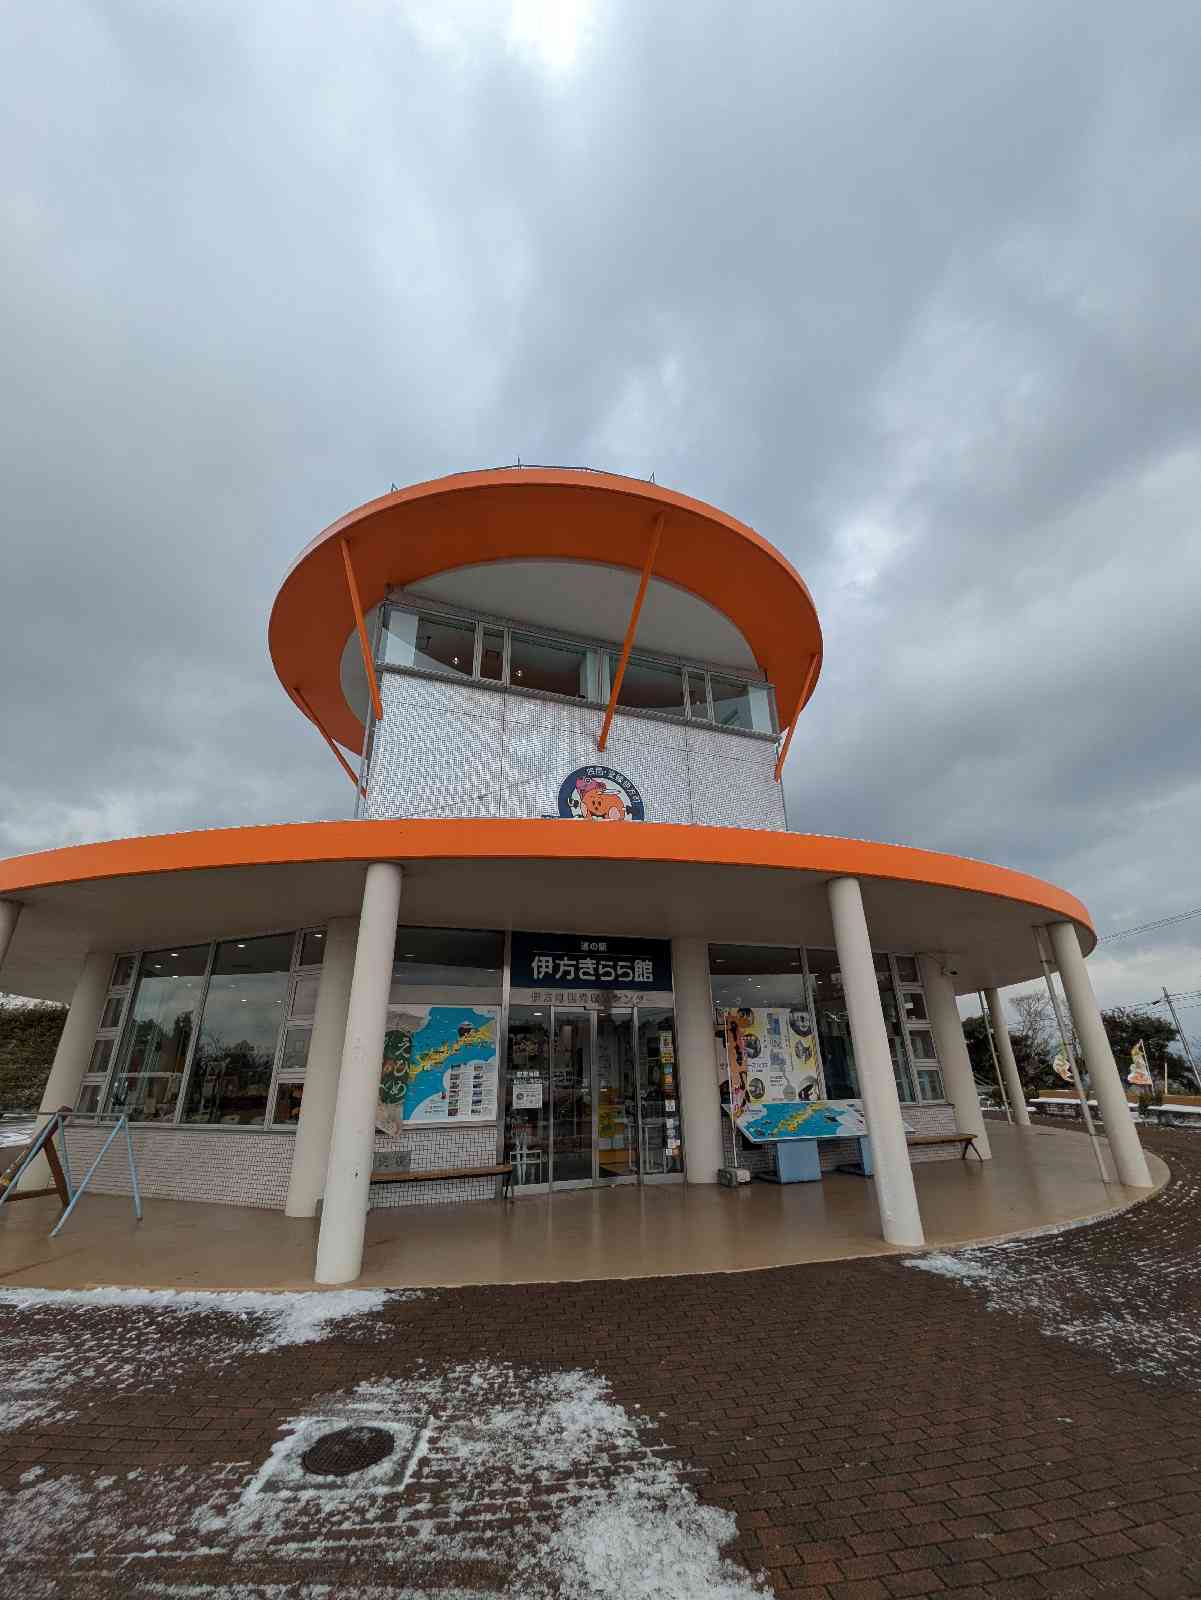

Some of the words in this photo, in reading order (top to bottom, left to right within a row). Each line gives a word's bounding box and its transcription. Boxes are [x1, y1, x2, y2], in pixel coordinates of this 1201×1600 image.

[531, 955, 654, 982] 伊方きらら館
